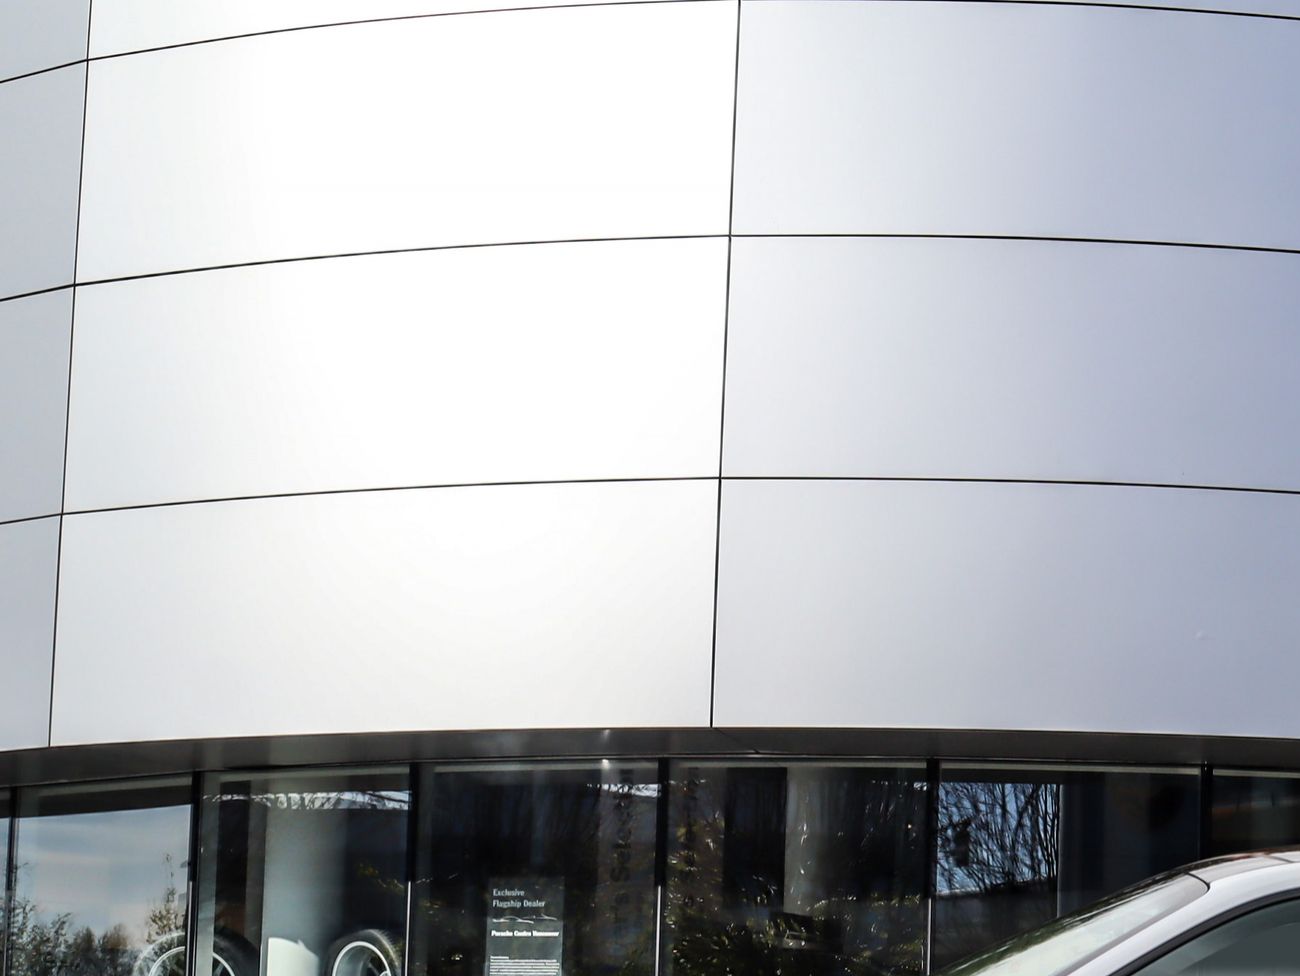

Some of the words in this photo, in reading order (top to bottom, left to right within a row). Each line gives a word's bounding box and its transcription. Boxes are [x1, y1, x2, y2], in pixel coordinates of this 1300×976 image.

[493, 888, 525, 896] Exclusive
[492, 900, 521, 909] Flagship
[523, 900, 545, 908] Dealer
